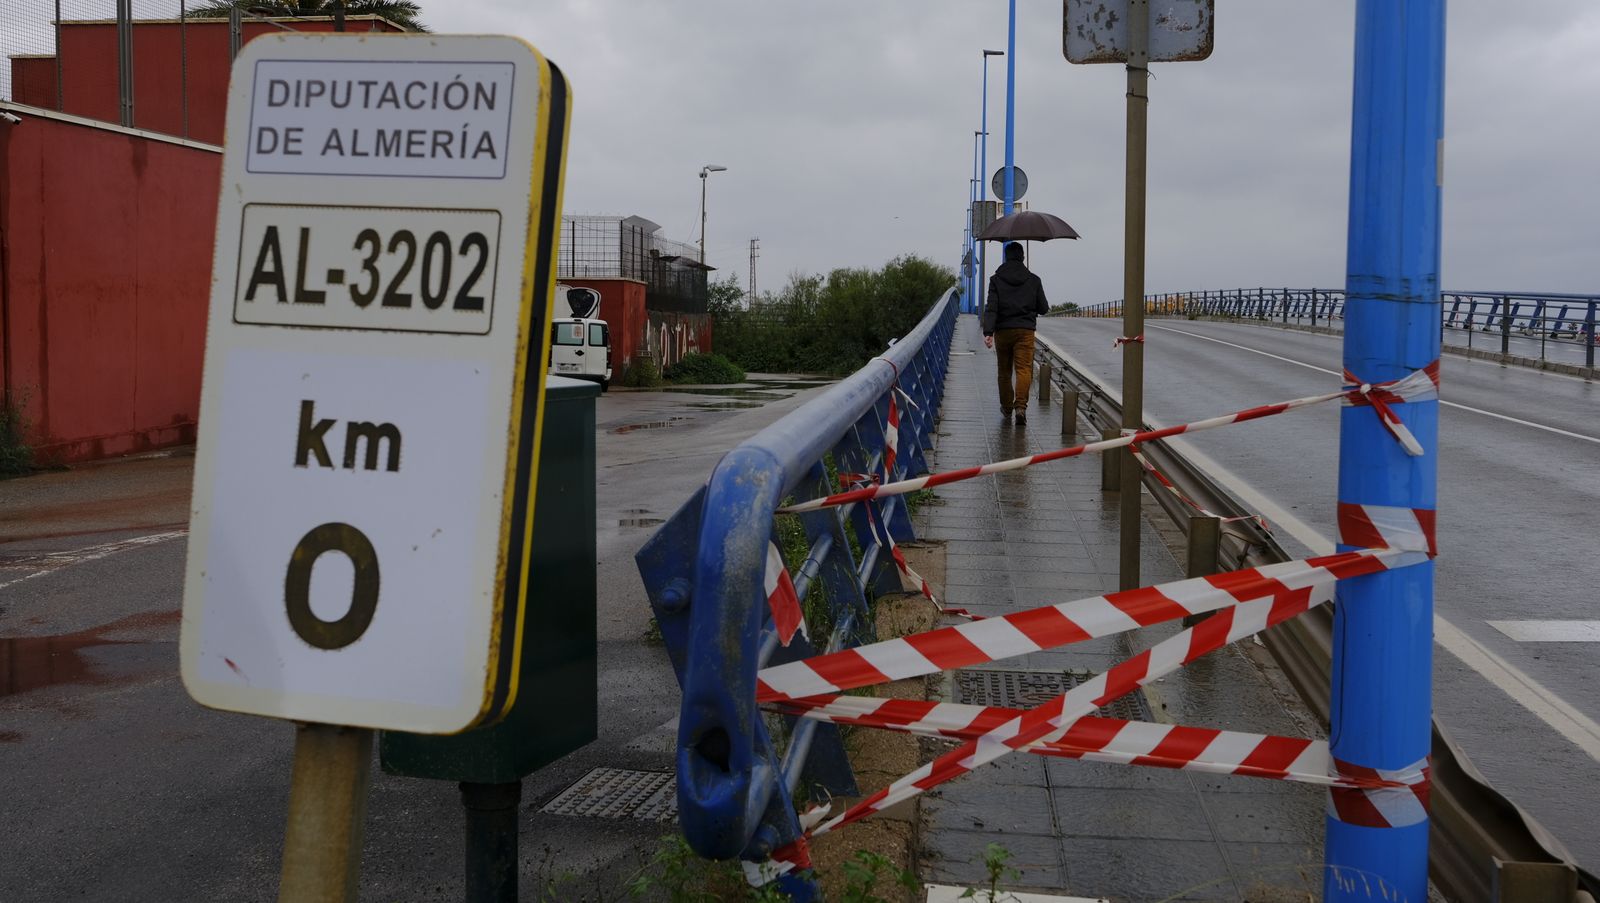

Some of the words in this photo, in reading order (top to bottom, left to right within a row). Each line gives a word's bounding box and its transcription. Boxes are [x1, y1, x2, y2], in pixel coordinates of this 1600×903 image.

[267, 74, 498, 111] DIPUTACIÓN
[256, 127, 305, 156] DE
[320, 123, 498, 160] ALMERÍA
[244, 225, 490, 312] AL-3202
[294, 400, 403, 473] km
[284, 522, 380, 651] 0
